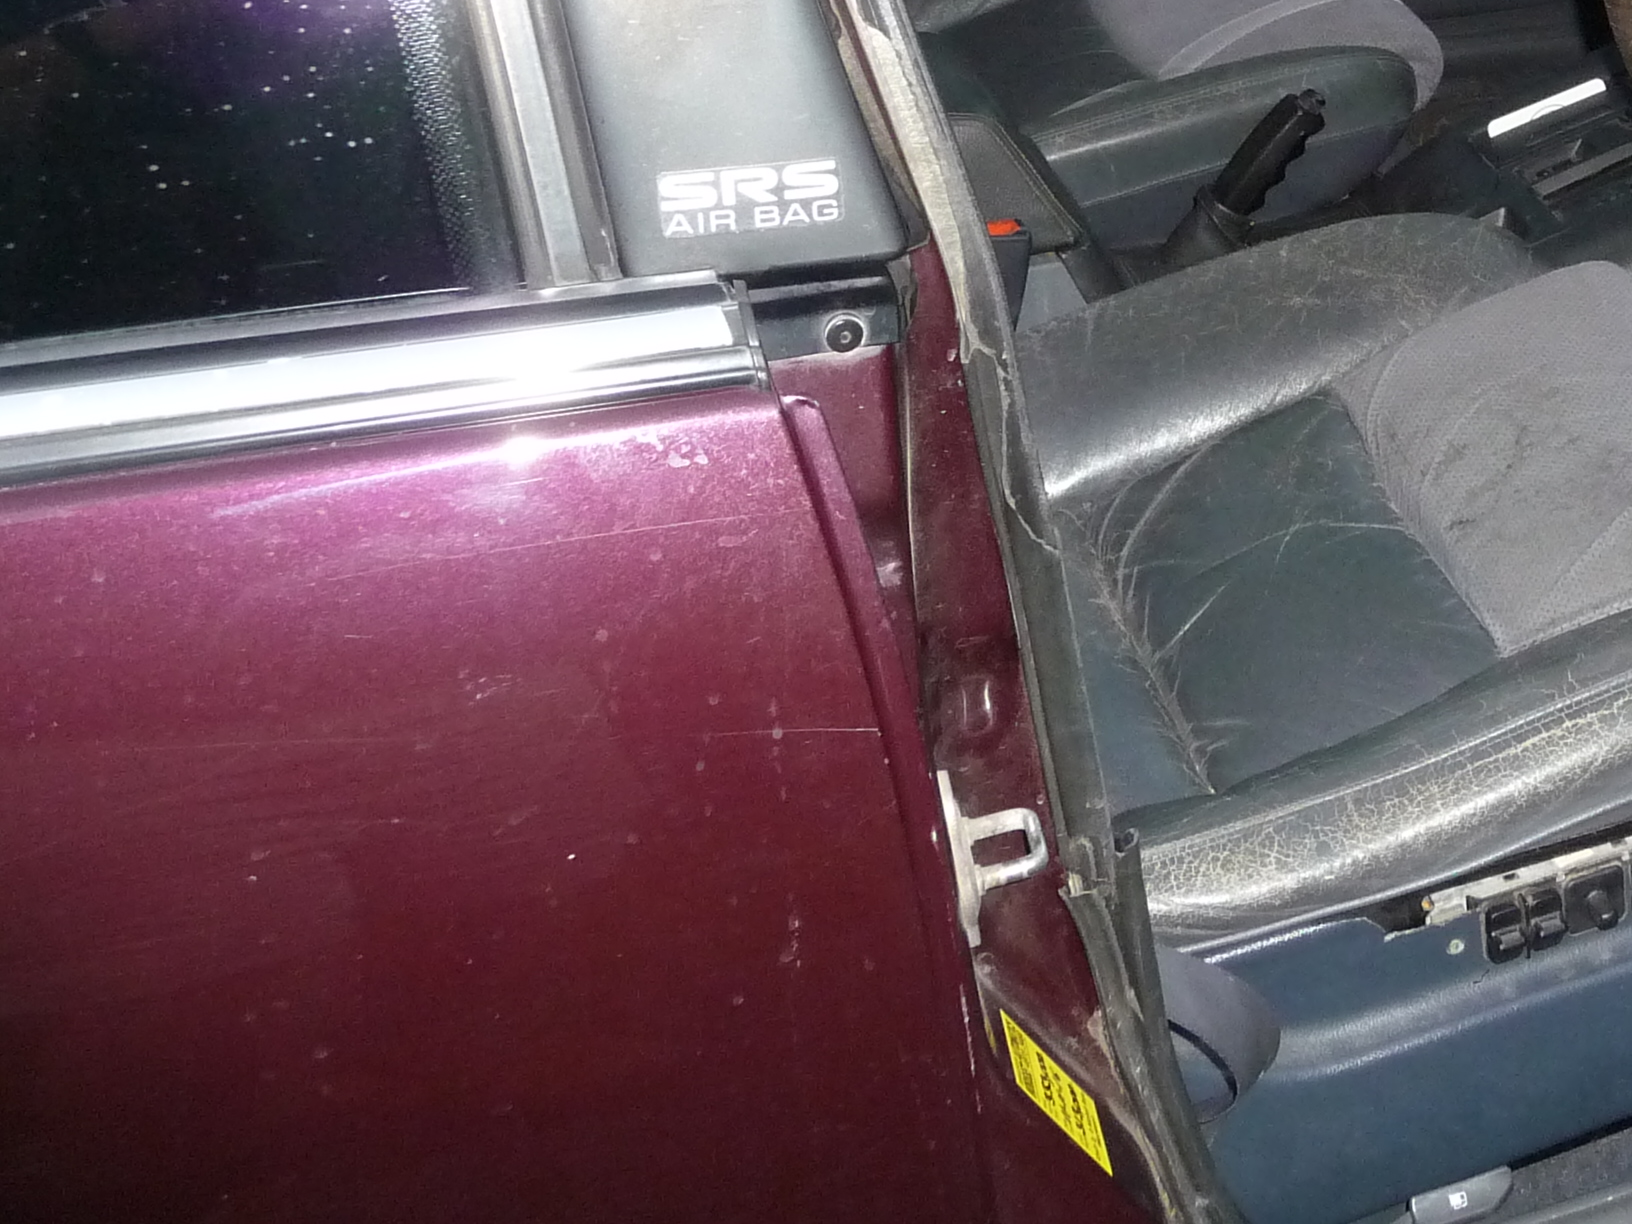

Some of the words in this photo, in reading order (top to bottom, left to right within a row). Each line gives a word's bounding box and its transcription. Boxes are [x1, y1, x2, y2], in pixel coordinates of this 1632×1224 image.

[659, 159, 839, 211] SRS
[664, 209, 736, 236] AIR
[752, 199, 839, 227] BAG
